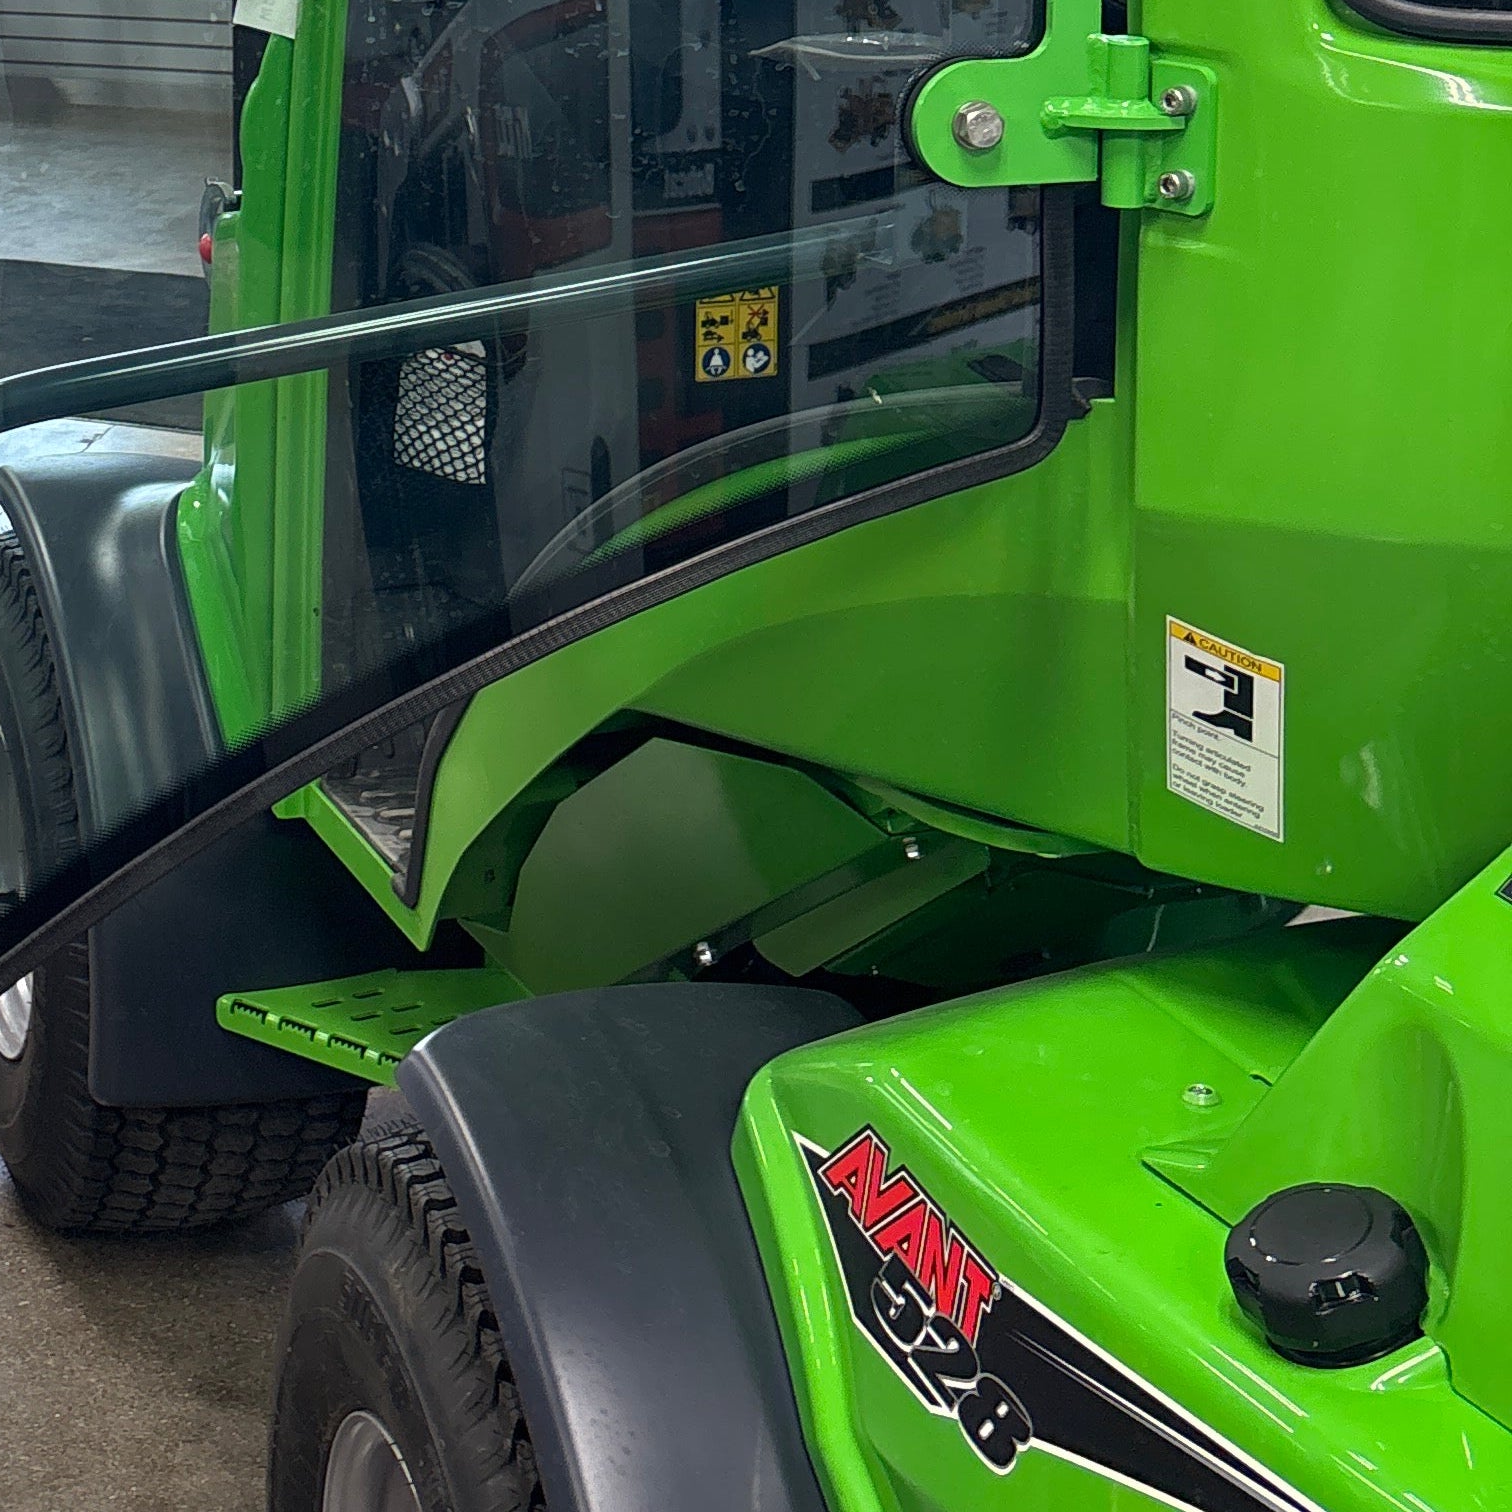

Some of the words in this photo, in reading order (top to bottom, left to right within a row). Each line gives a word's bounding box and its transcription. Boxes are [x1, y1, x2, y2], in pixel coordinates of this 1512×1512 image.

[1199, 637, 1263, 674] CAUTION
[819, 1123, 1001, 1346] AVANT
[871, 1254, 1035, 1475] 528
